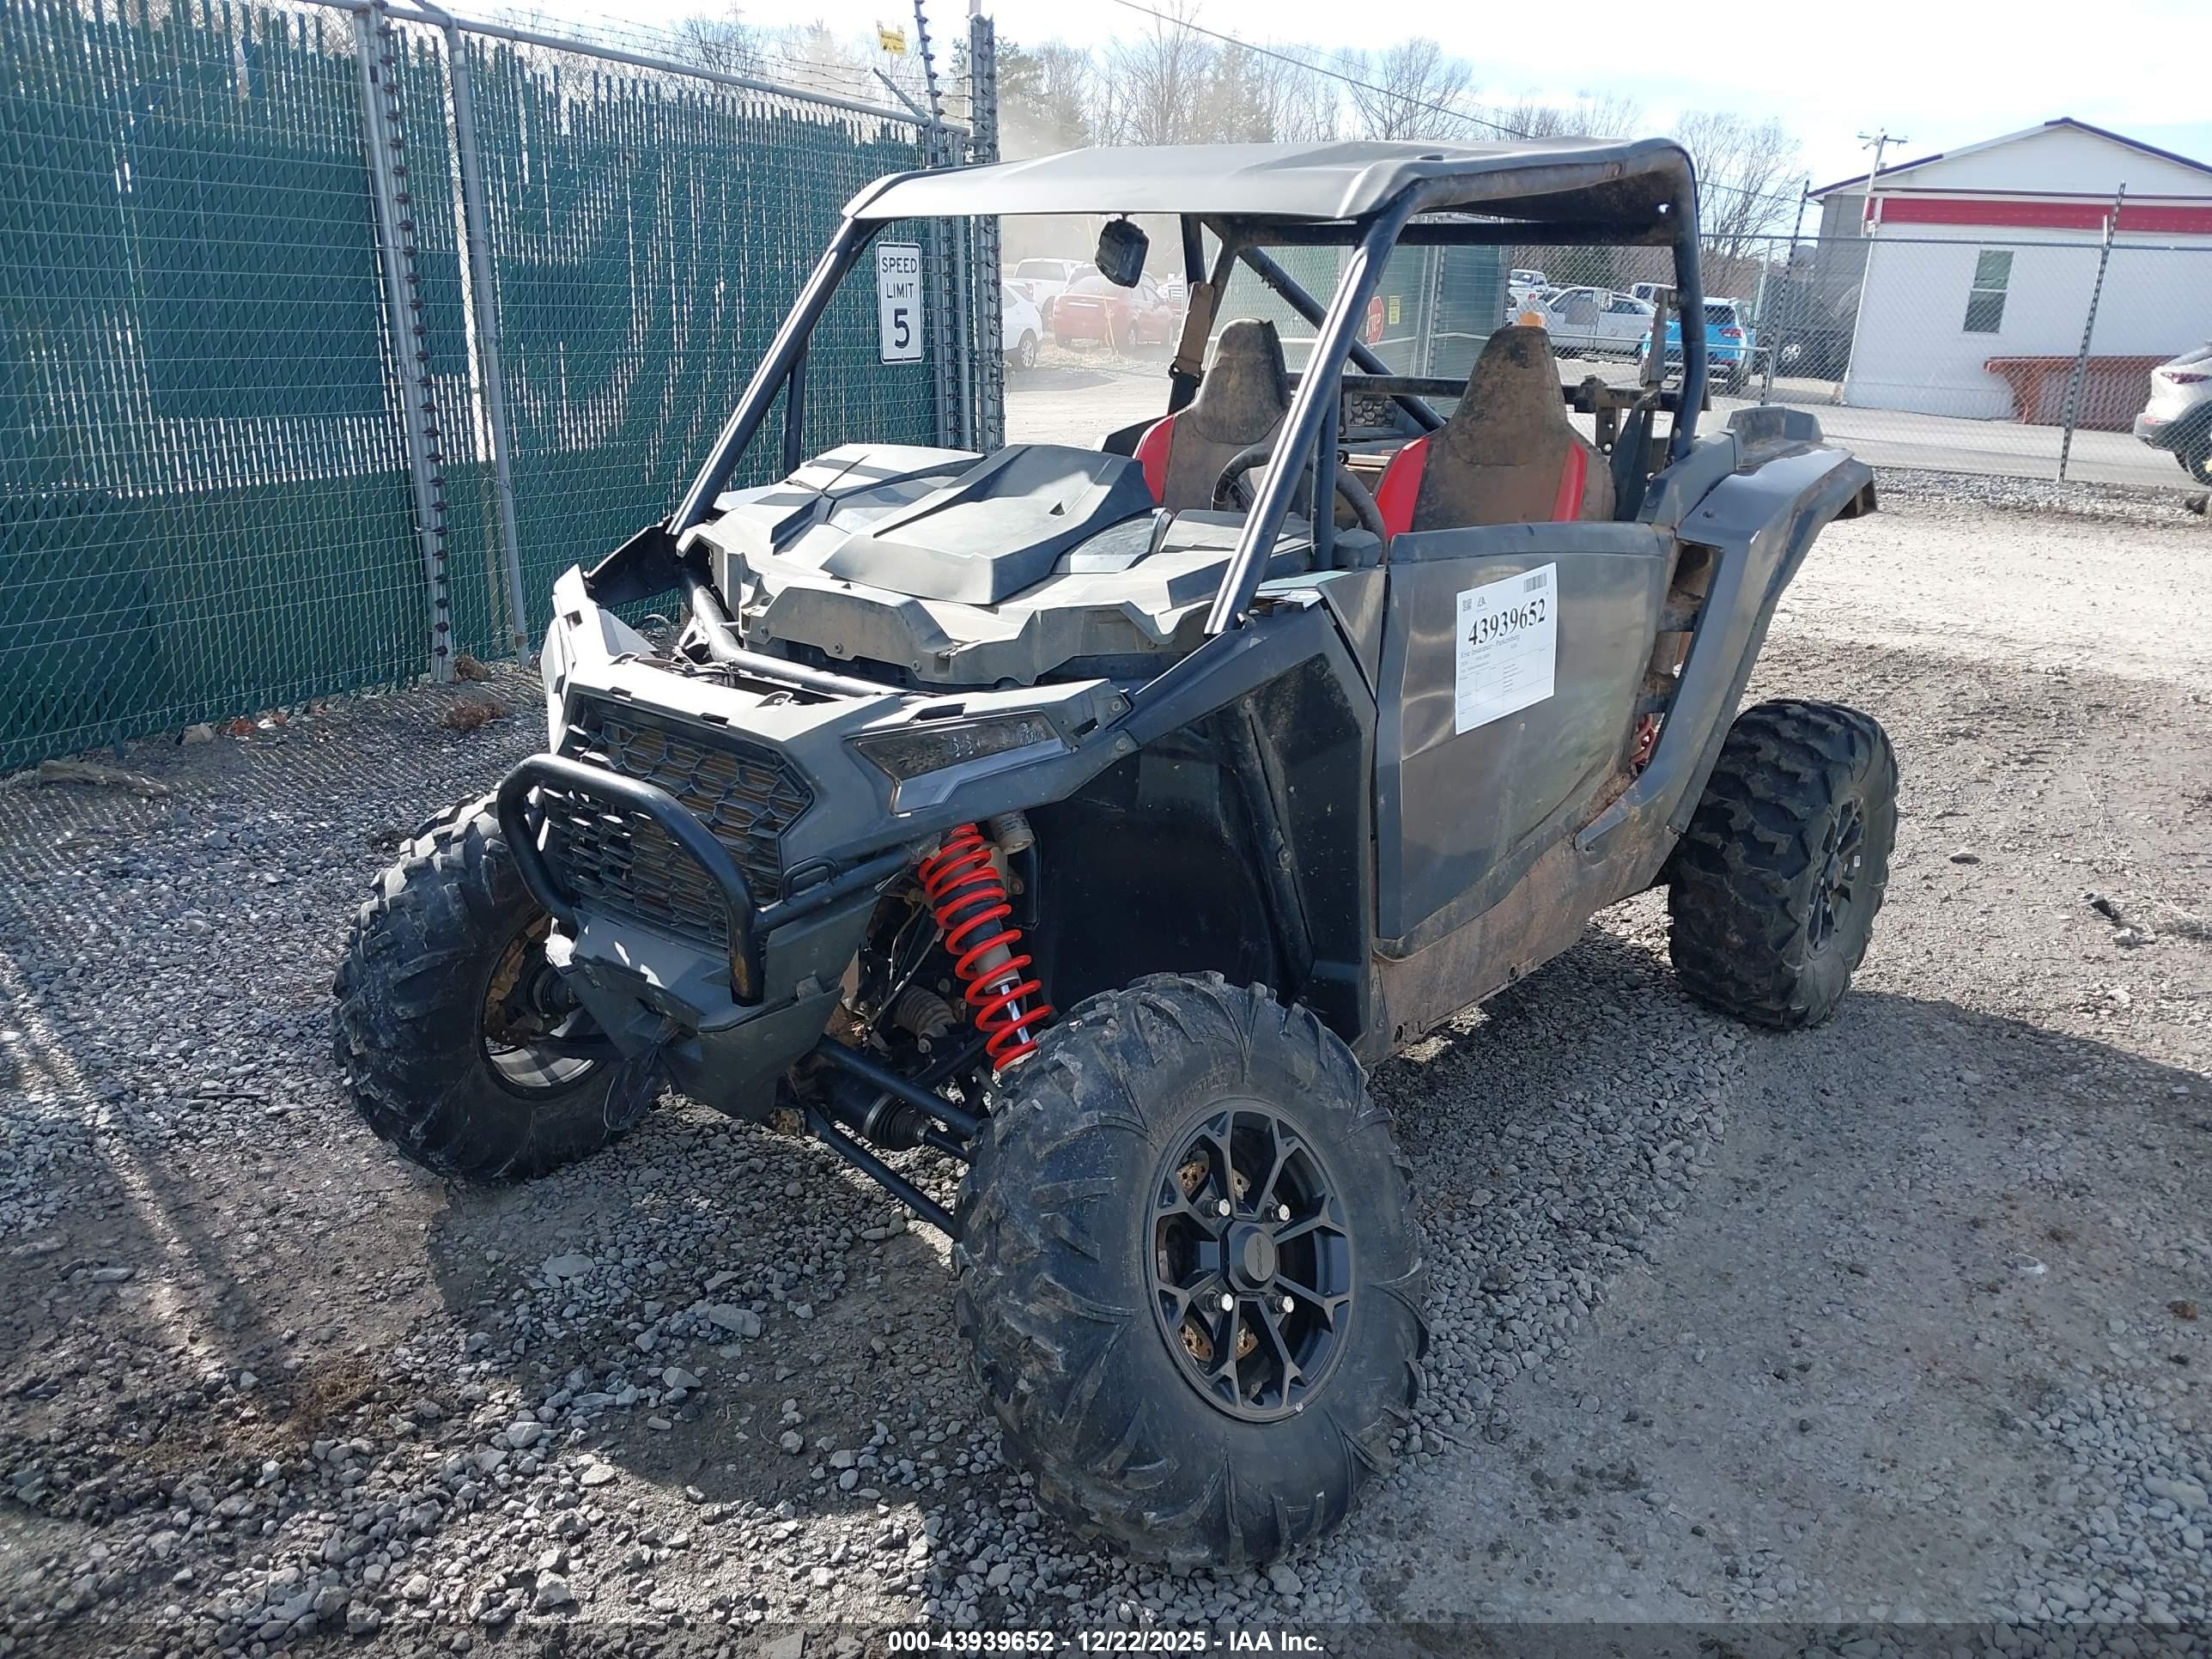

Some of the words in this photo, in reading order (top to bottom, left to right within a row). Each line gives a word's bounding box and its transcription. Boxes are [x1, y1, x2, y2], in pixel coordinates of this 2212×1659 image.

[881, 257, 918, 273] SPEED
[885, 283, 915, 299] LIMIT
[894, 307, 910, 349] 5
[1369, 313, 1382, 335] STOP
[1468, 599, 1546, 645] 43939652
